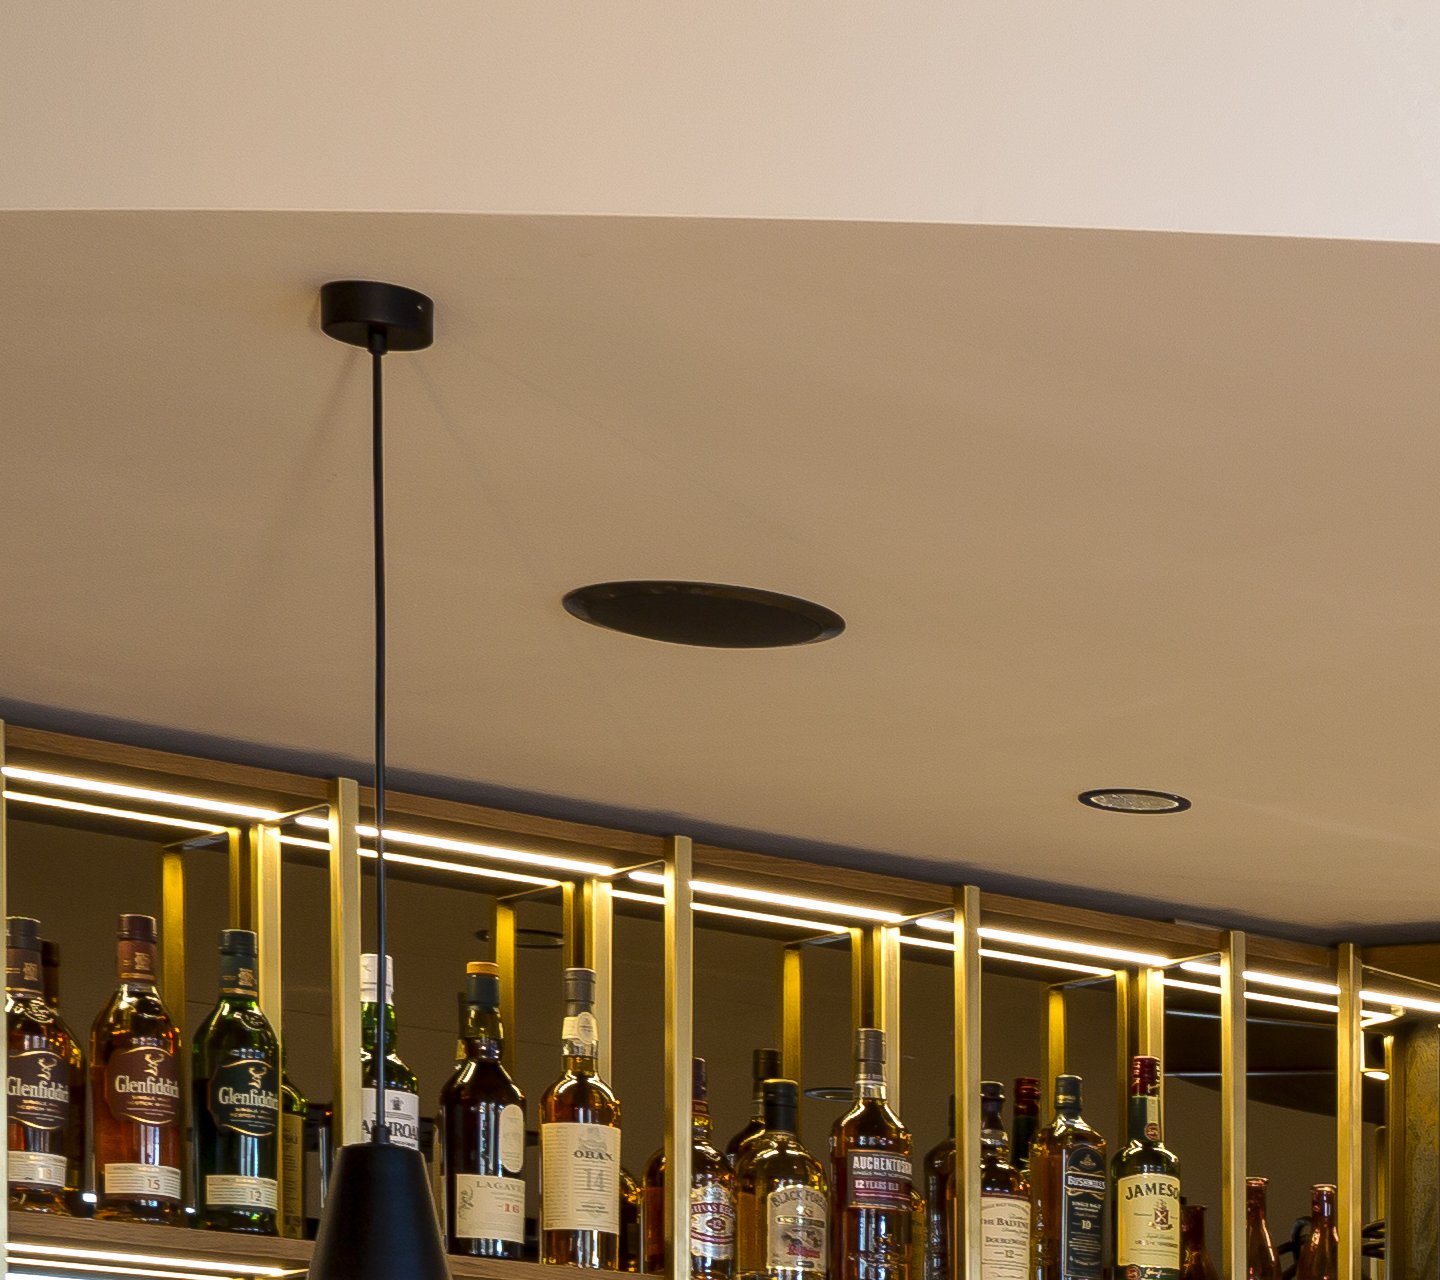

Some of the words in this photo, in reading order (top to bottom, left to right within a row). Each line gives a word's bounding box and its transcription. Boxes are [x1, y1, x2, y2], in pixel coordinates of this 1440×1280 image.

[573, 1150, 614, 1161] OBAN
[147, 1178, 161, 1190] 15
[854, 1179, 864, 1189] 12
[249, 1190, 262, 1201] 12
[503, 1203, 520, 1214] 16
